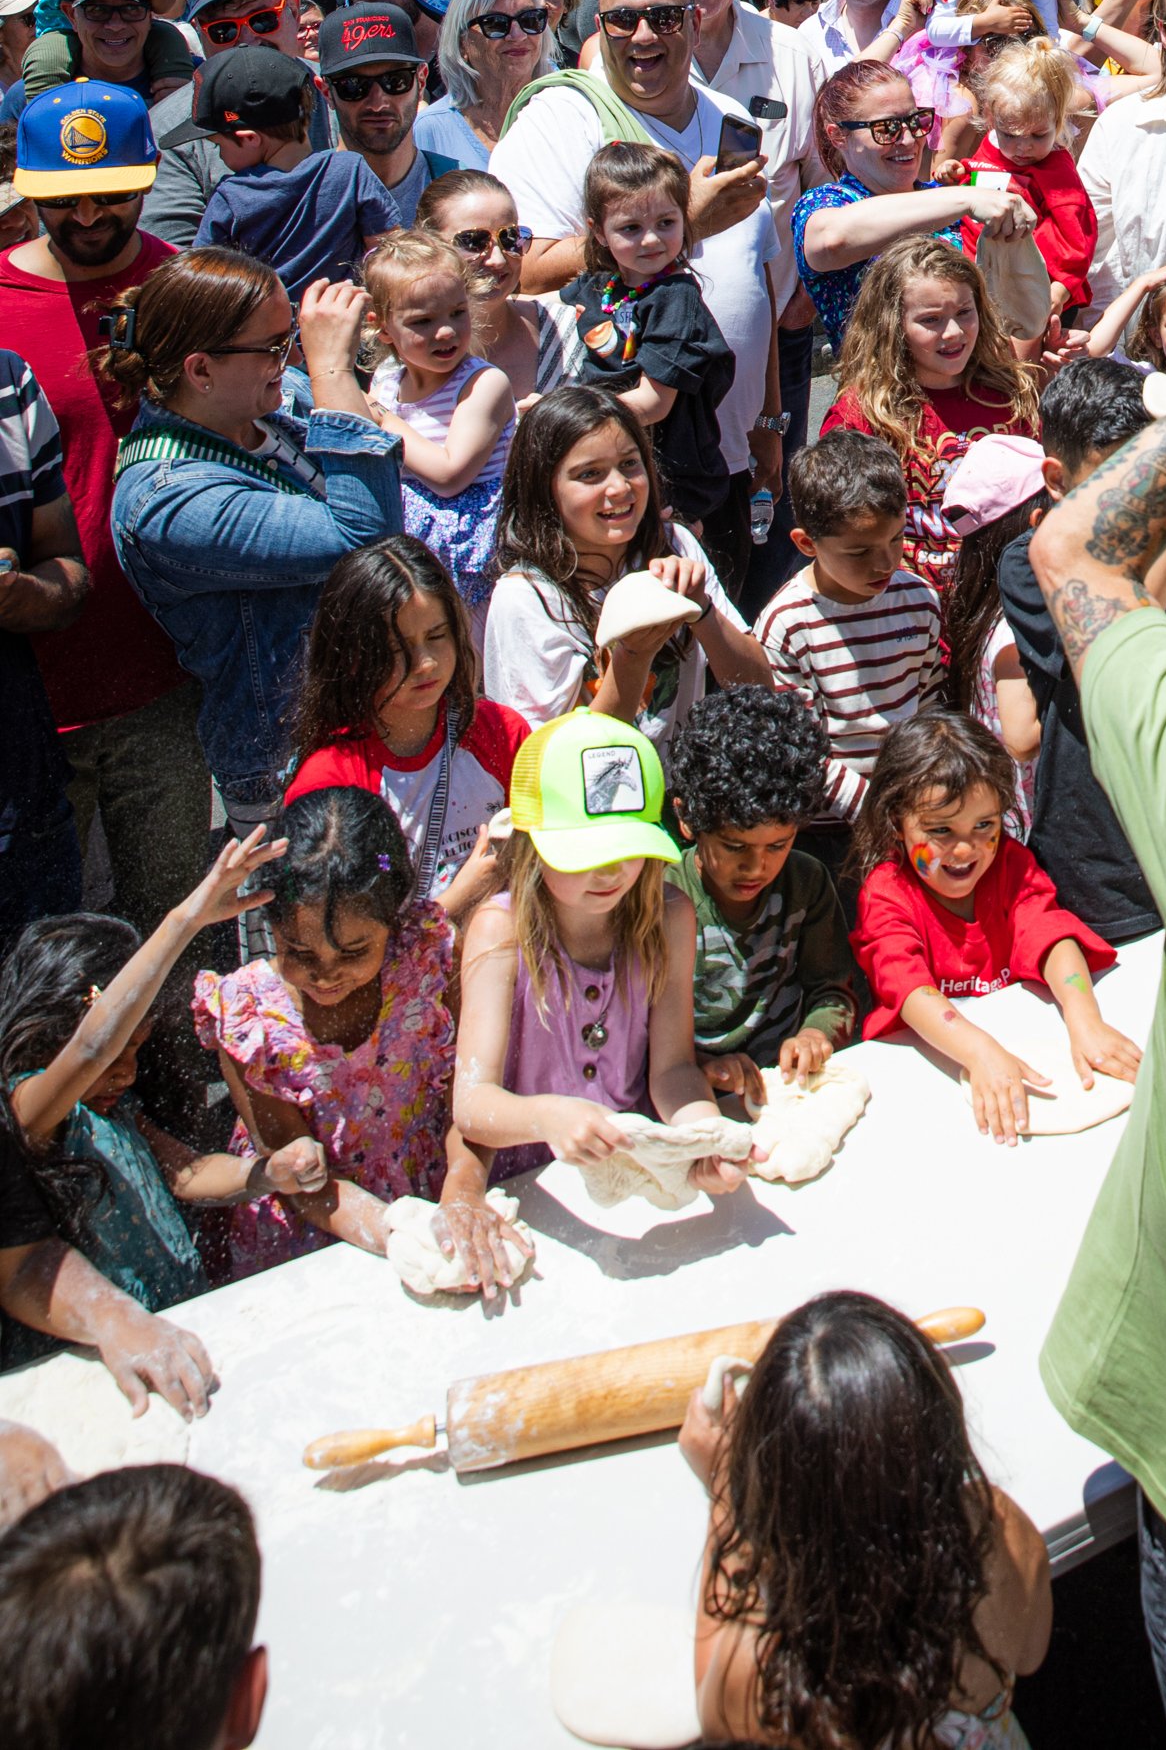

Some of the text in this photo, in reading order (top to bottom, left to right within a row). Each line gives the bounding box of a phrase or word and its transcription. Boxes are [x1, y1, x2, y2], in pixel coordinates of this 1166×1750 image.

[341, 23, 397, 52] 49ers
[61, 147, 109, 166] WARRIORS
[588, 750, 616, 759] LEGEND
[940, 975, 1003, 994] Heritage
